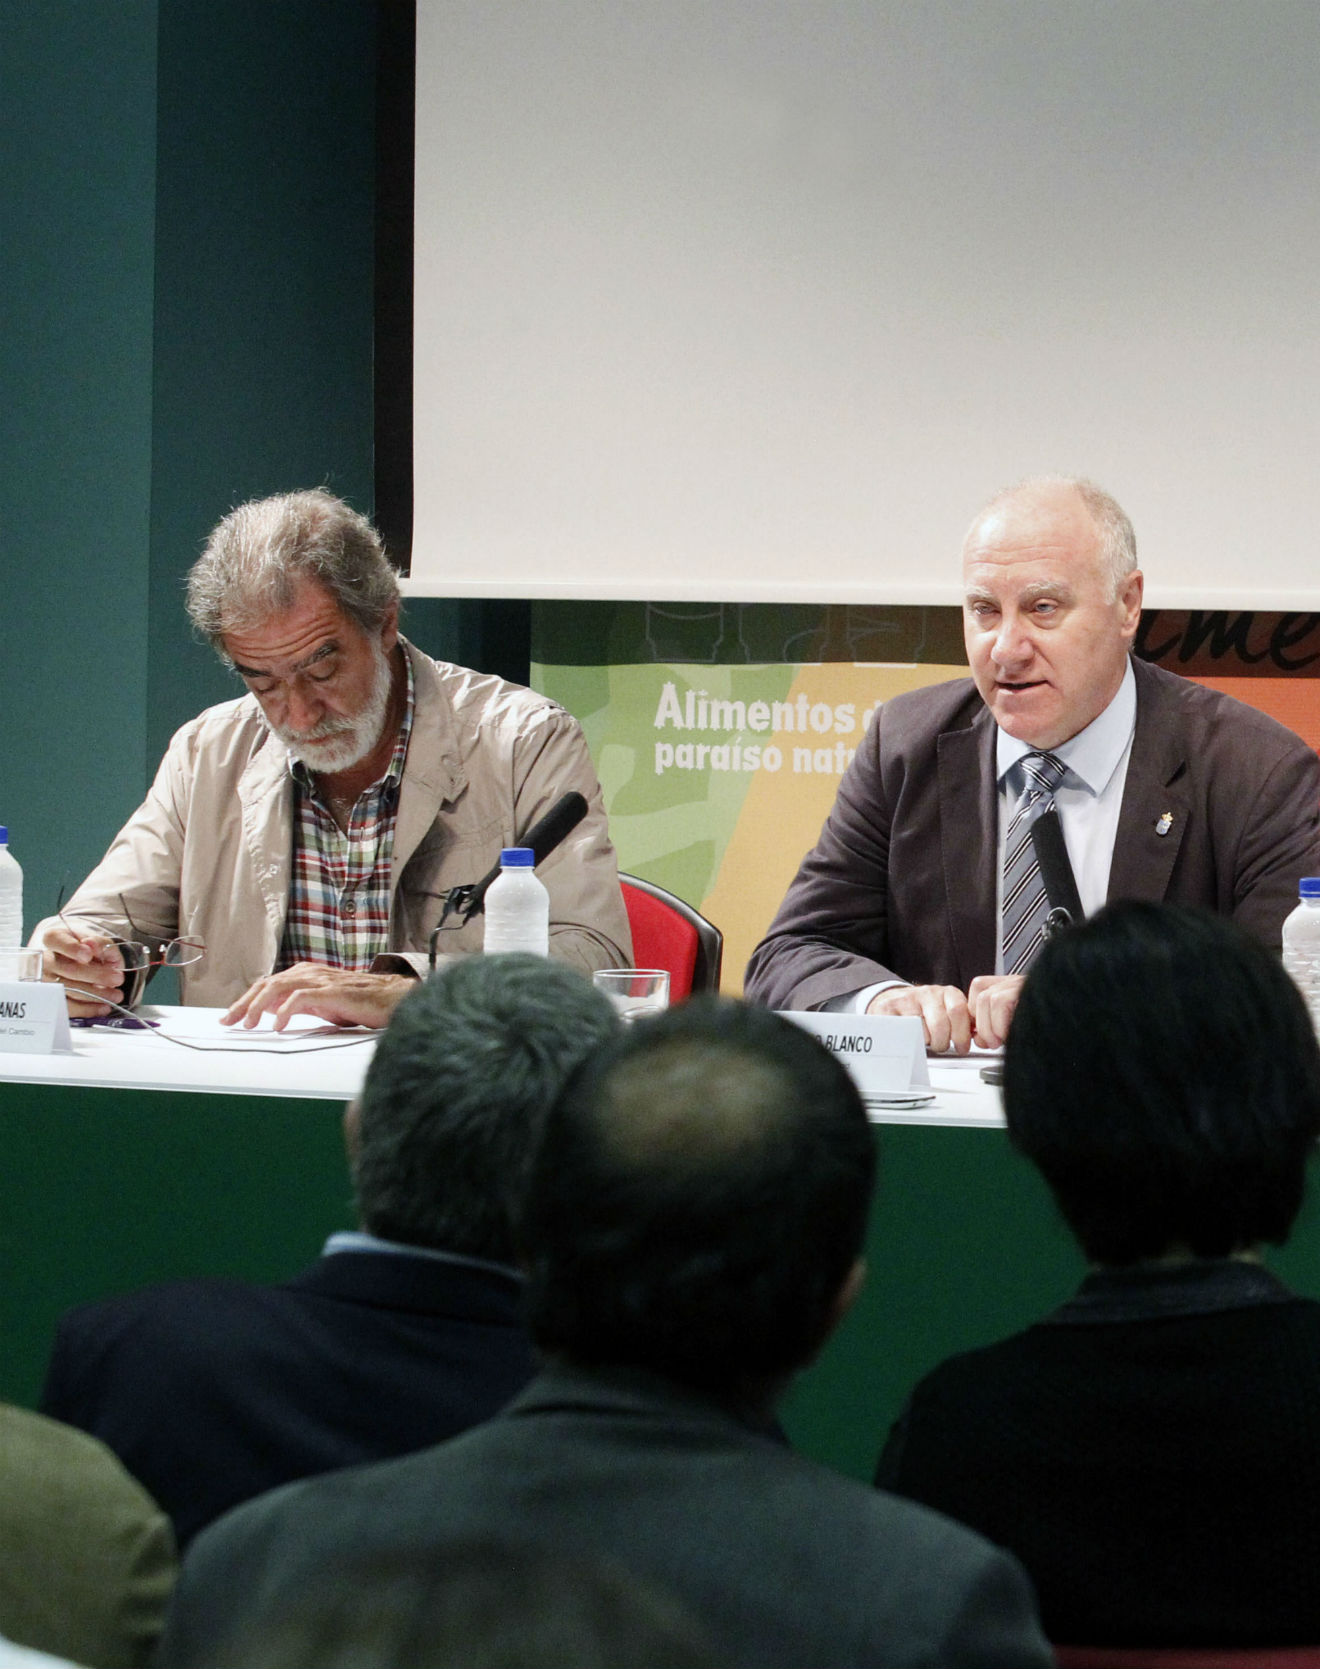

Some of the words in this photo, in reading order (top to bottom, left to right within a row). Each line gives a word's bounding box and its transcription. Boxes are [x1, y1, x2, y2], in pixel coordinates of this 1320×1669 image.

[653, 681, 856, 734] Alimentos
[654, 736, 783, 776] paraíso
[824, 1034, 873, 1053] BLANCO
